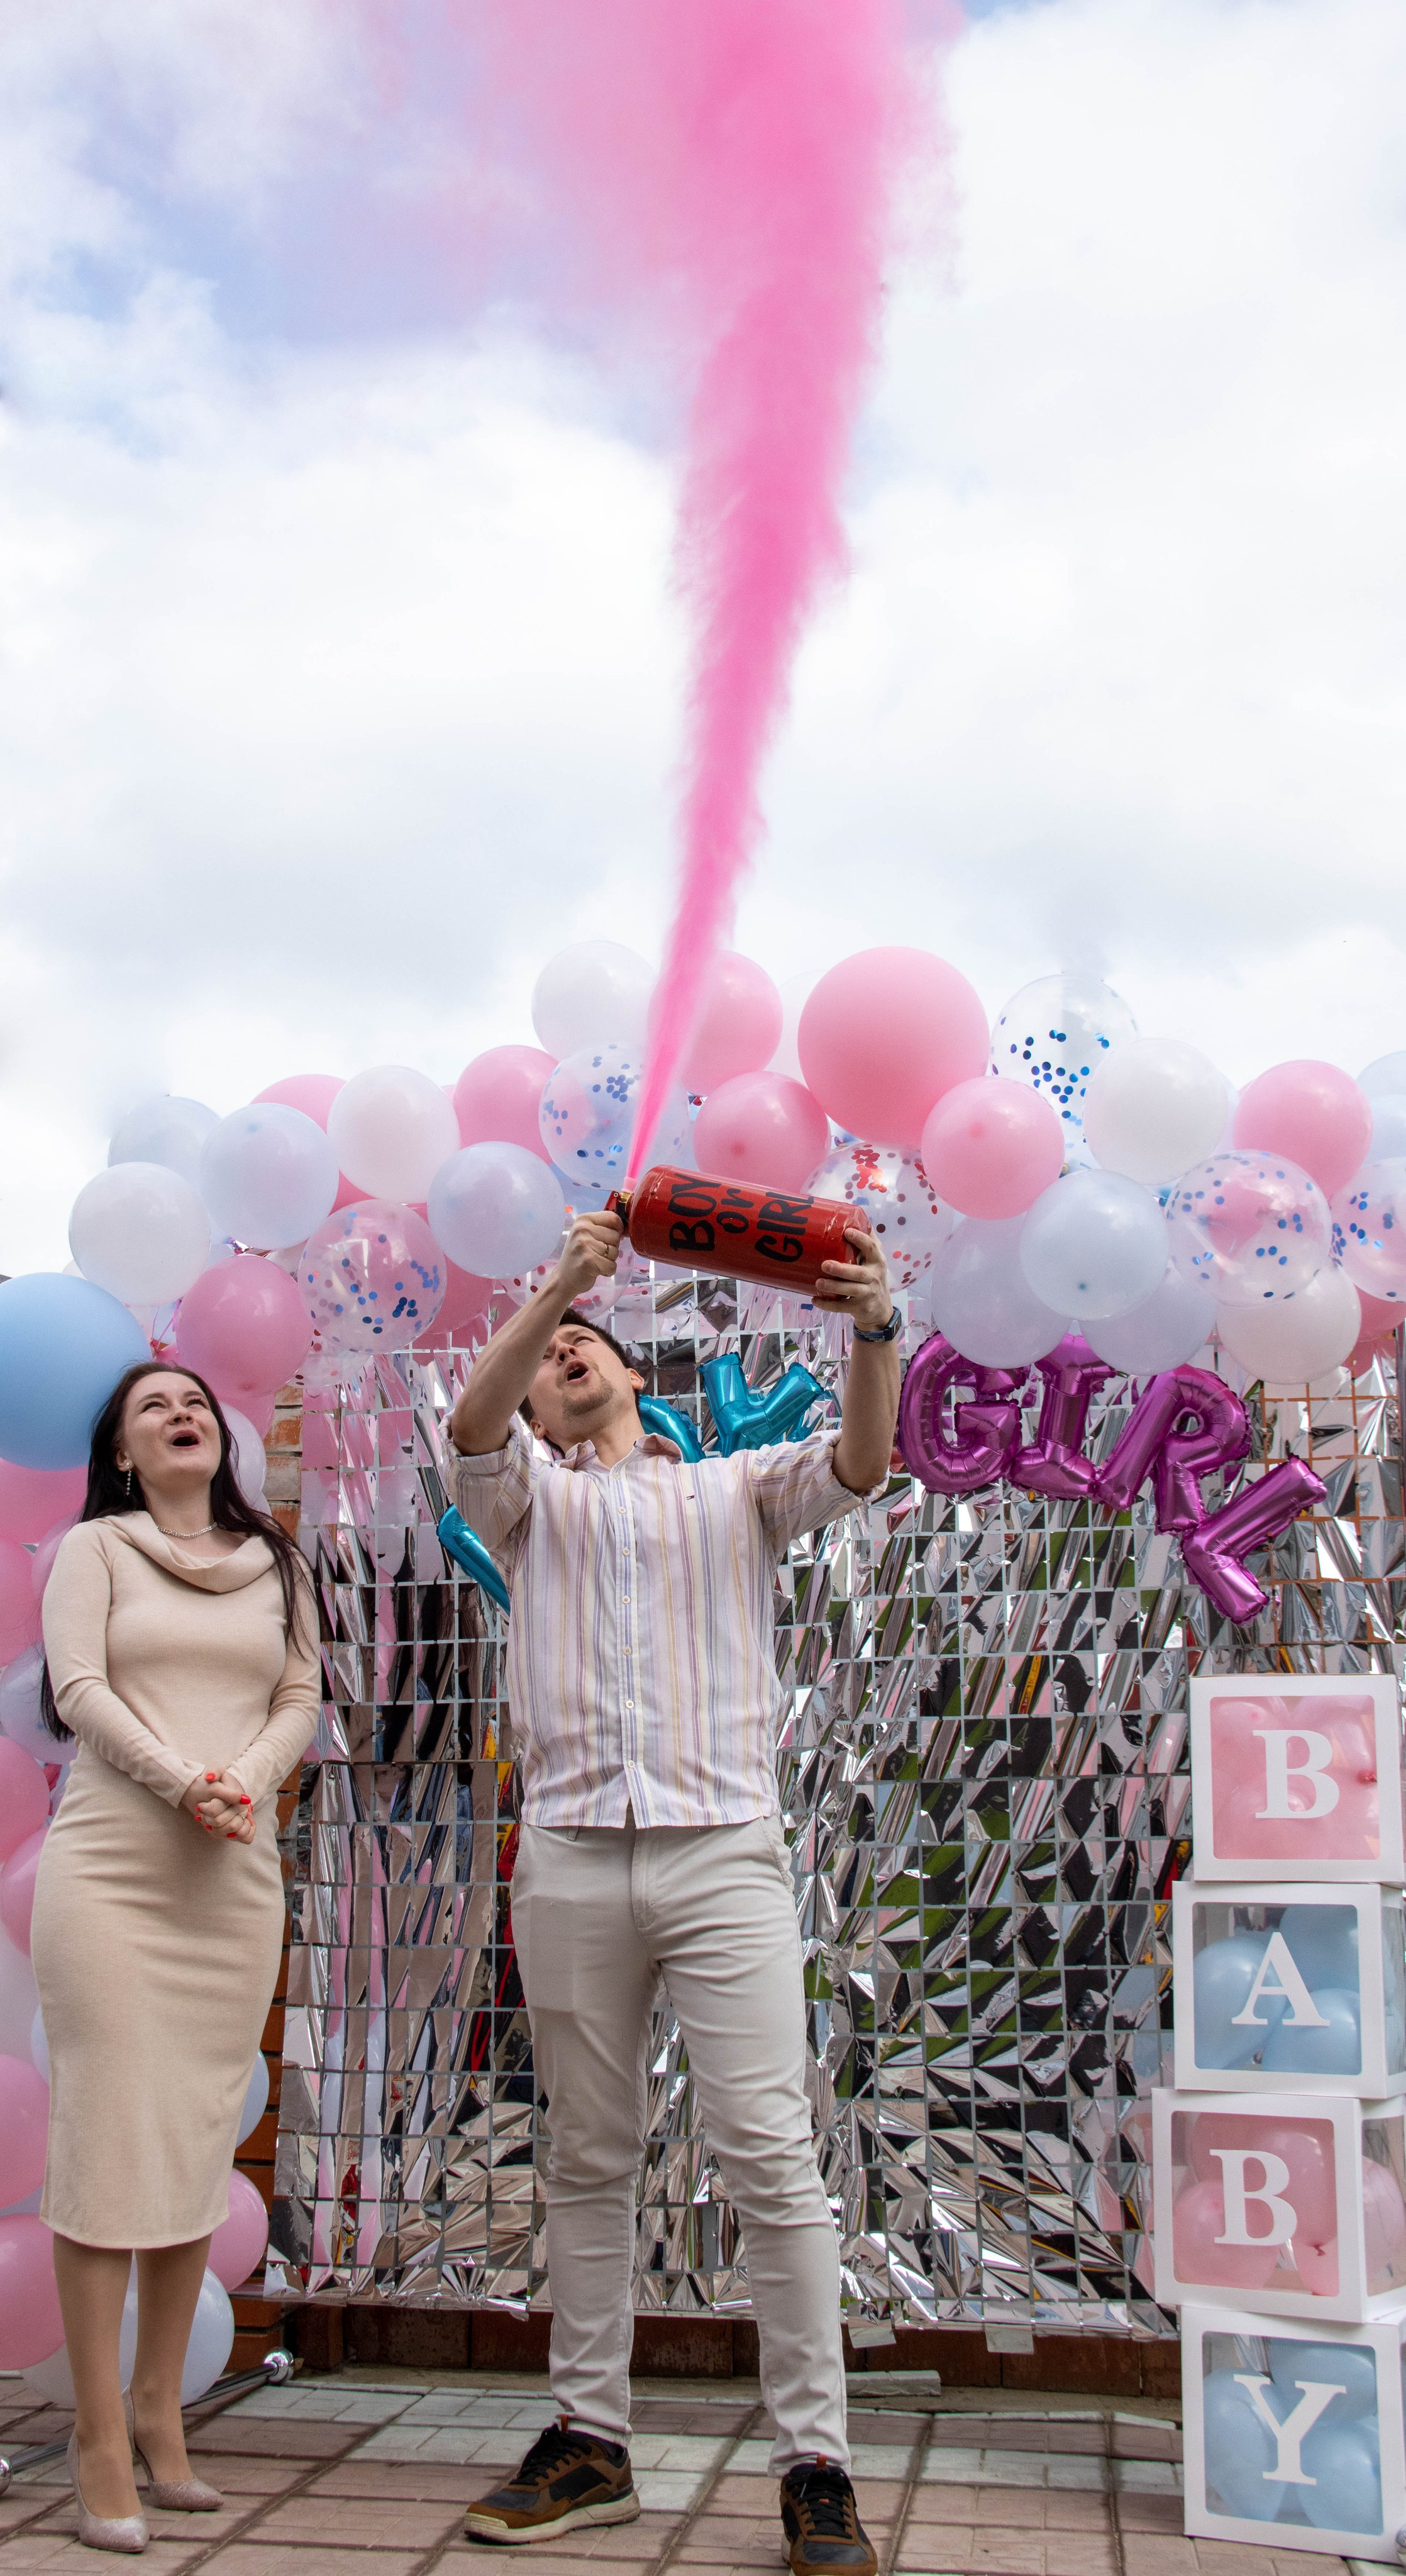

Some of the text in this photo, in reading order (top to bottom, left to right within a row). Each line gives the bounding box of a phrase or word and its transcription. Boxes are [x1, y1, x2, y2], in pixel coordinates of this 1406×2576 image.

[668, 1174, 721, 1252] BOY
[755, 1192, 814, 1263] GIRL
[897, 1331, 1327, 1626] GIRL
